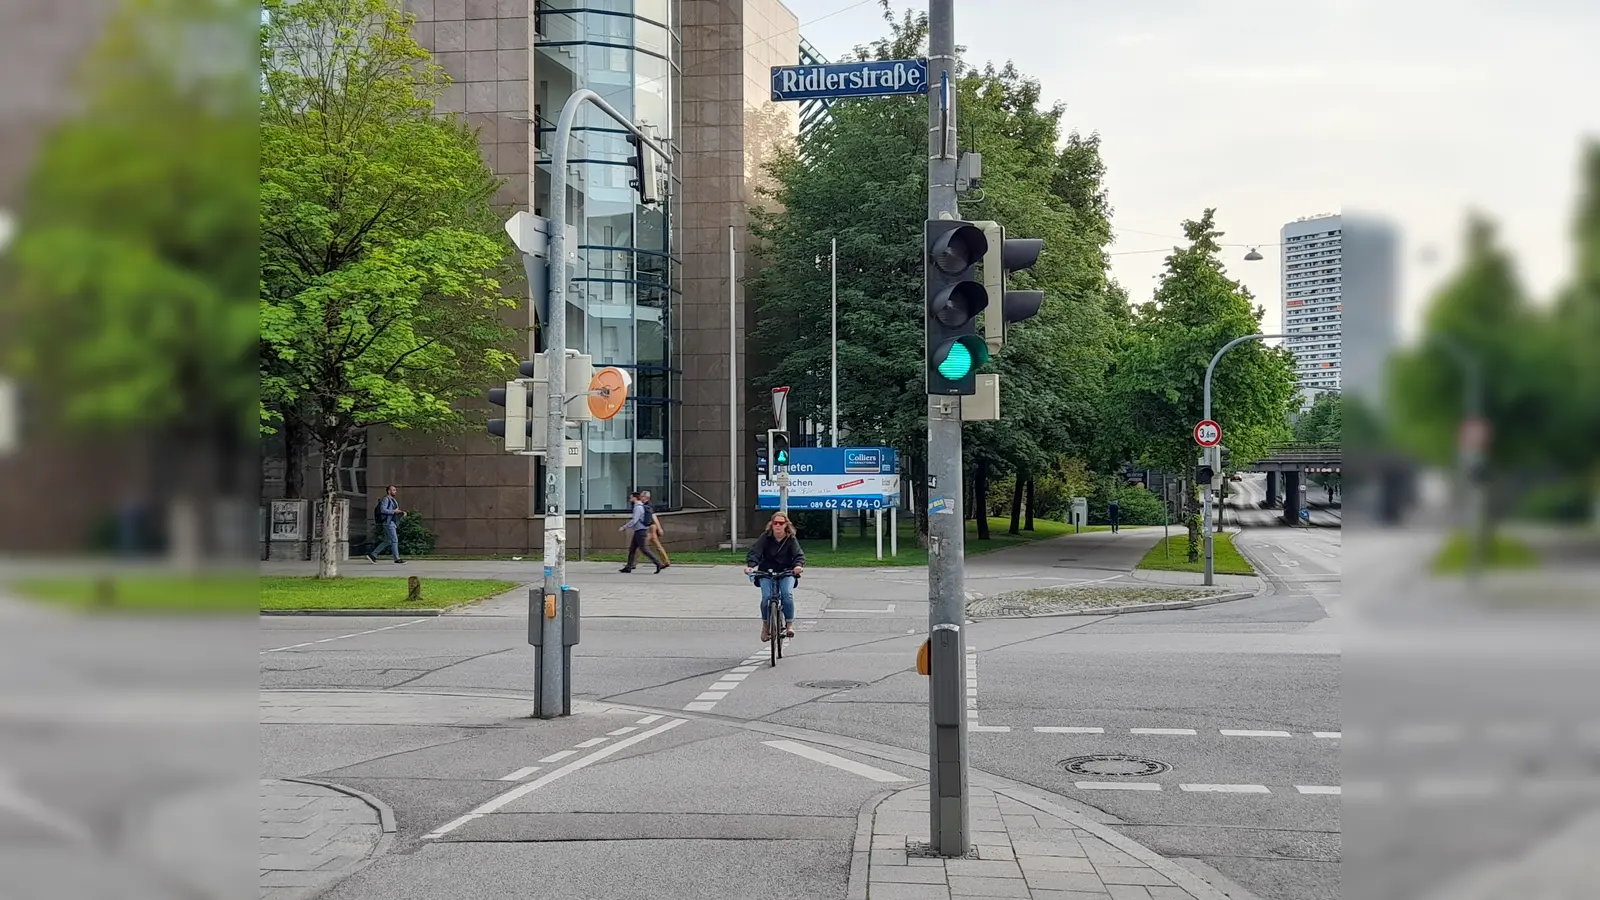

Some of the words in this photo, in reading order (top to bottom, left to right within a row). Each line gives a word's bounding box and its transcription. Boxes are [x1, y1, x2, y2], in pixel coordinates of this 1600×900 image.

[782, 63, 920, 92] Ridlerstraße
[848, 453, 877, 461] Colliers
[825, 499, 837, 508] 62
[840, 499, 853, 508] 42
[856, 499, 881, 508] 94-0
